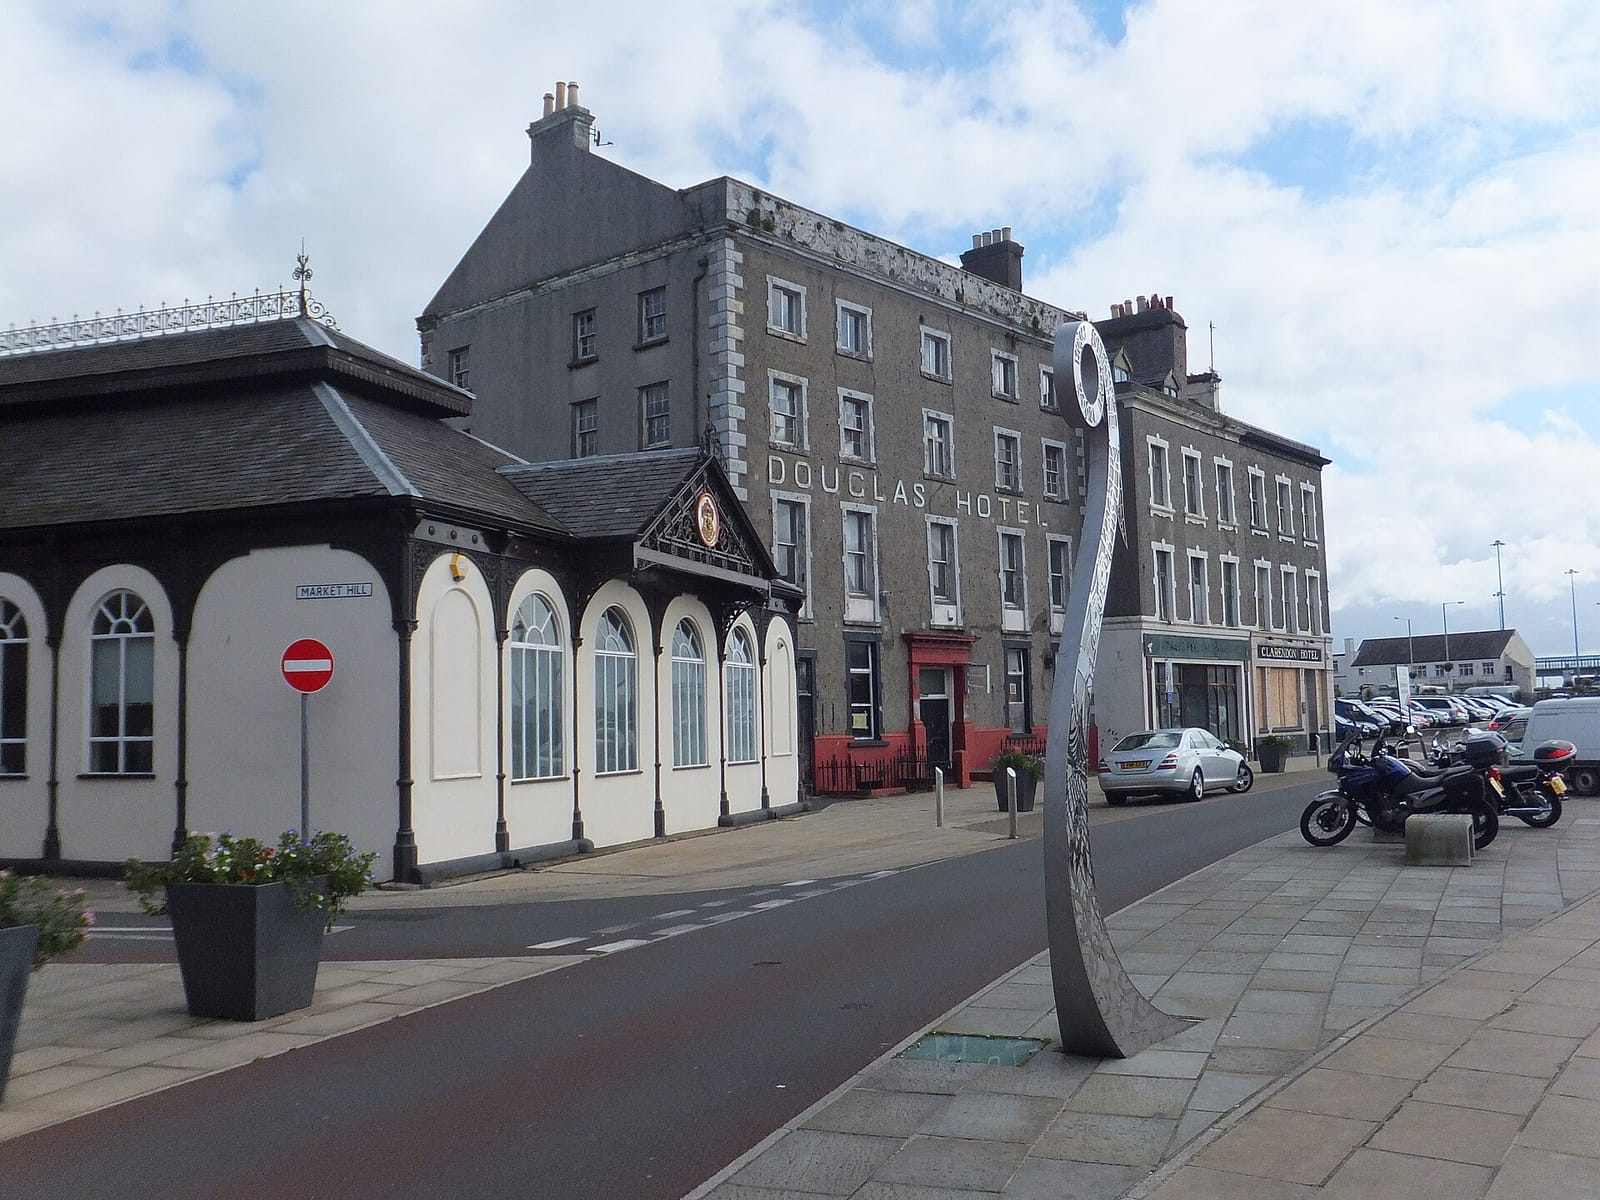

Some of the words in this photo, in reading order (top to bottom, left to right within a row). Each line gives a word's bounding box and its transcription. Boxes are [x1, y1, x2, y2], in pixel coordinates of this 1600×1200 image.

[768, 455, 926, 509] DOUGLAS
[955, 490, 1049, 528] HOTEL
[301, 586, 342, 597] MARKET
[346, 585, 367, 595] HILL
[1300, 648, 1319, 660] HOTEL
